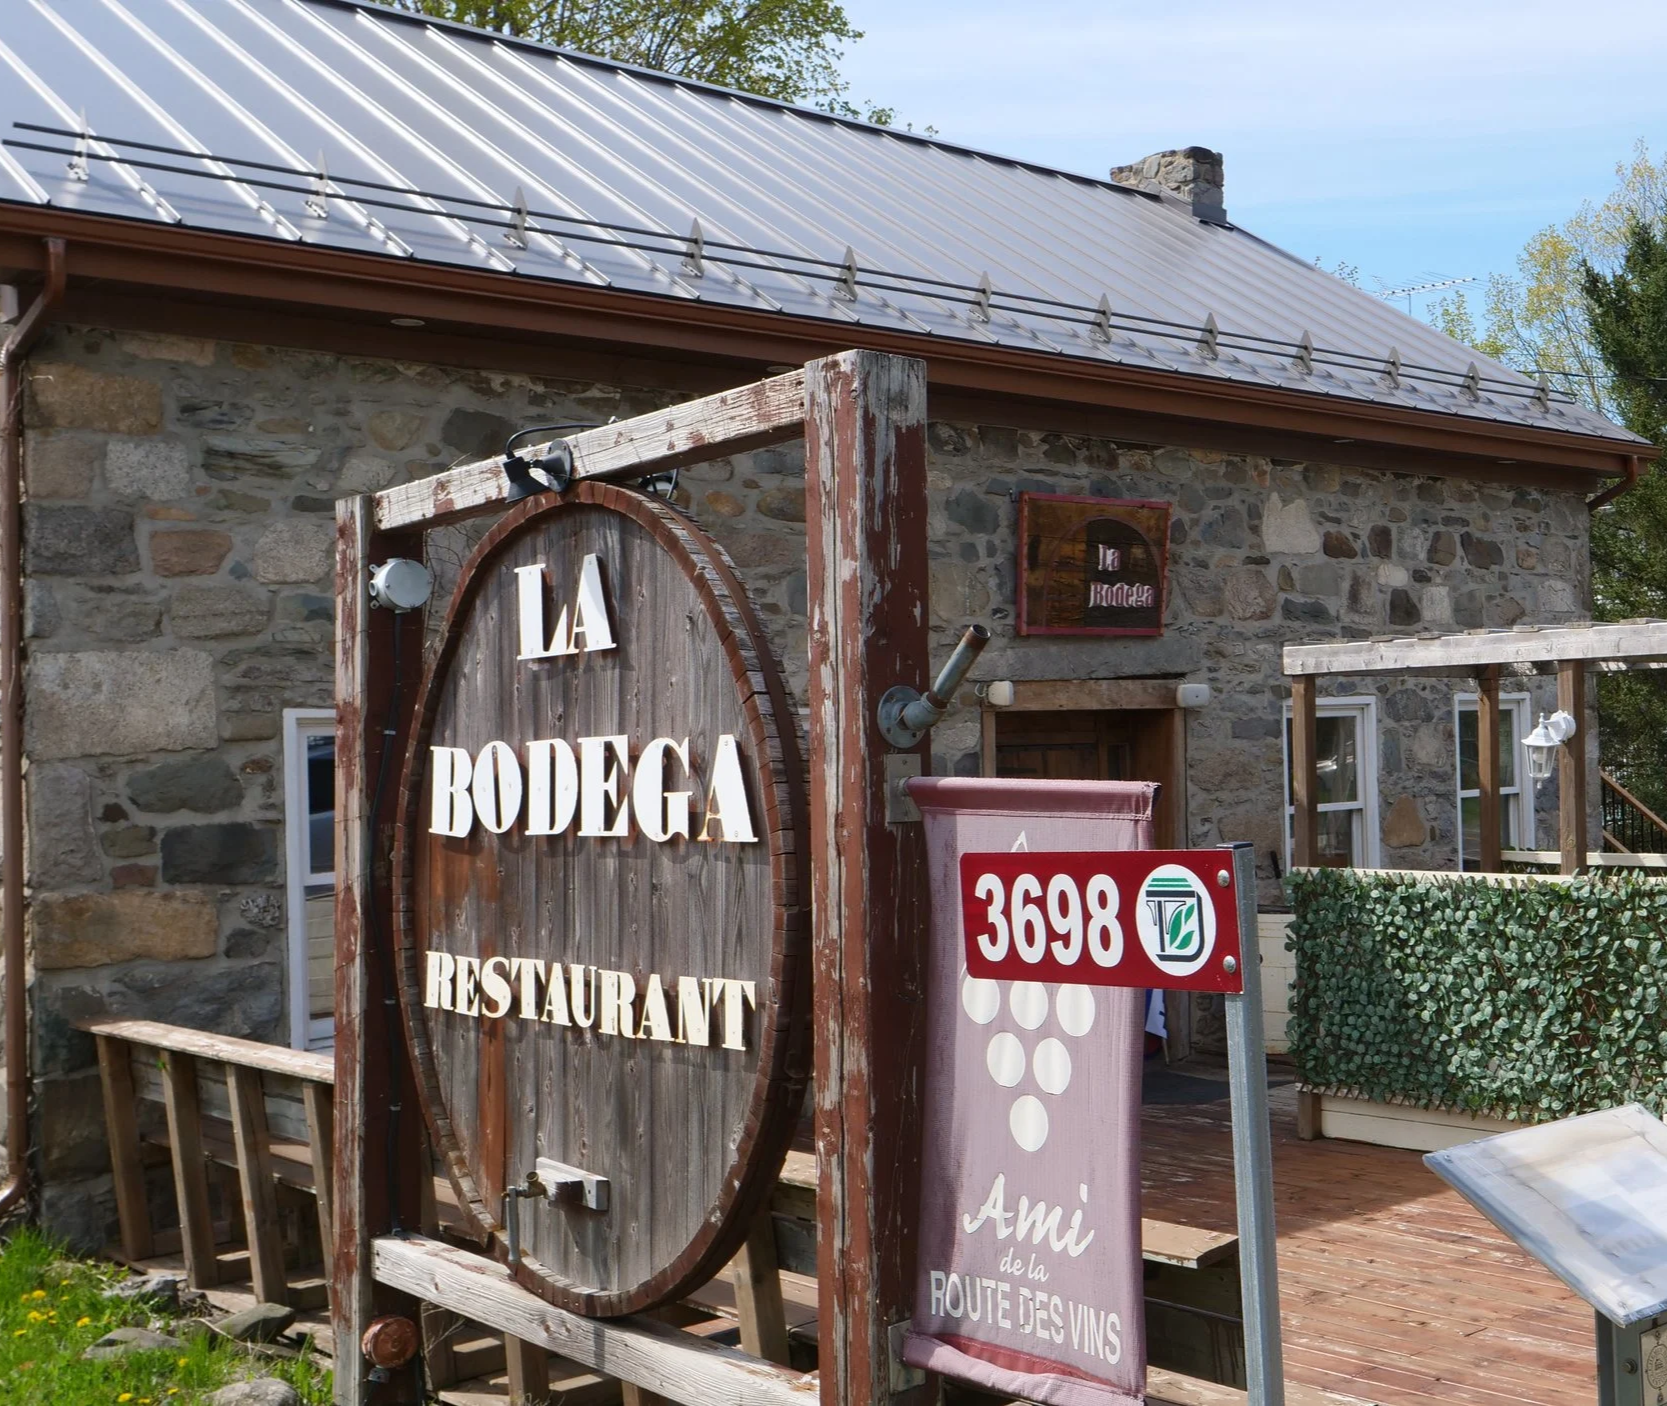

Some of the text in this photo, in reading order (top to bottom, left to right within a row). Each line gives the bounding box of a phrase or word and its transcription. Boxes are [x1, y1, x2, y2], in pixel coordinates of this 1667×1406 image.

[1089, 582, 1155, 608] Bodega
[1098, 544, 1121, 571] La
[513, 553, 617, 660] LA
[428, 733, 759, 843] BODEGA
[974, 873, 1124, 968] 3698
[424, 950, 756, 1051] RESTAURANT
[963, 1172, 1095, 1257] Ami
[1000, 1247, 1049, 1282] de la
[930, 1270, 1121, 1364] ROUTE DES VINS
